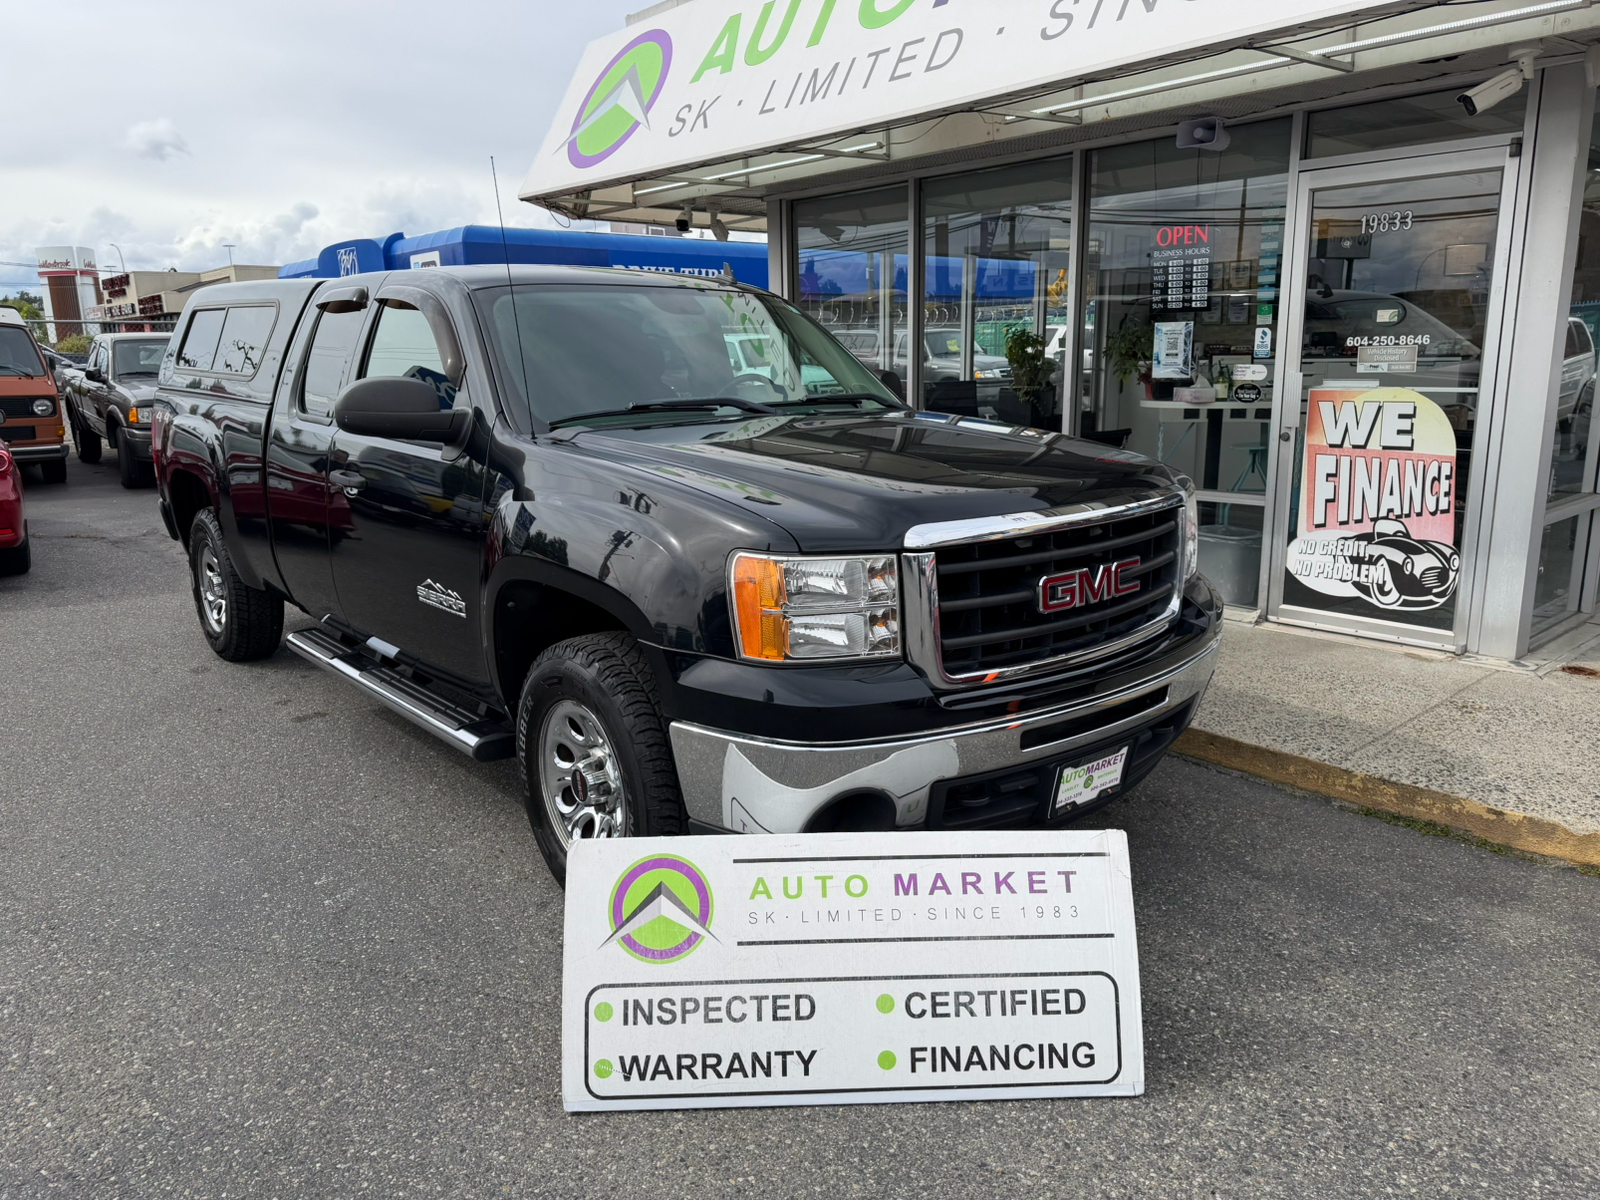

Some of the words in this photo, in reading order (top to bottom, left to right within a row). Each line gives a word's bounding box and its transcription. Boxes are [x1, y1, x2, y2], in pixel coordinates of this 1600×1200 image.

[668, 94, 724, 138] SK
[758, 28, 963, 115] LIMITED
[1157, 224, 1210, 248] OPEN
[1361, 210, 1413, 235] 19833
[1153, 249, 1183, 257] BUSINESS
[1185, 247, 1210, 255] HOURS
[1346, 335, 1430, 346] 604-250-8646
[1387, 348, 1408, 356] History
[1374, 354, 1400, 362] Disclosed
[1317, 401, 1416, 450] WE
[1313, 453, 1452, 528] FINANCE
[1298, 539, 1317, 554] NO
[1319, 540, 1369, 561] CREDIT,
[1038, 555, 1140, 614] GMC
[1293, 559, 1312, 576] NO
[1314, 561, 1385, 585] PROBLEM
[416, 585, 466, 613] SIERRA
[749, 874, 869, 901] AUTO
[893, 870, 1077, 897] MARKET
[748, 911, 775, 924] SK
[801, 908, 902, 923] LIMITED
[927, 906, 1000, 921] SINCE
[1020, 905, 1078, 919] 1983
[622, 994, 816, 1026] INSPECTED
[904, 988, 1086, 1019] CERTIFIED
[619, 1049, 818, 1082] WARRANTY
[910, 1041, 1096, 1074] FINANCING
